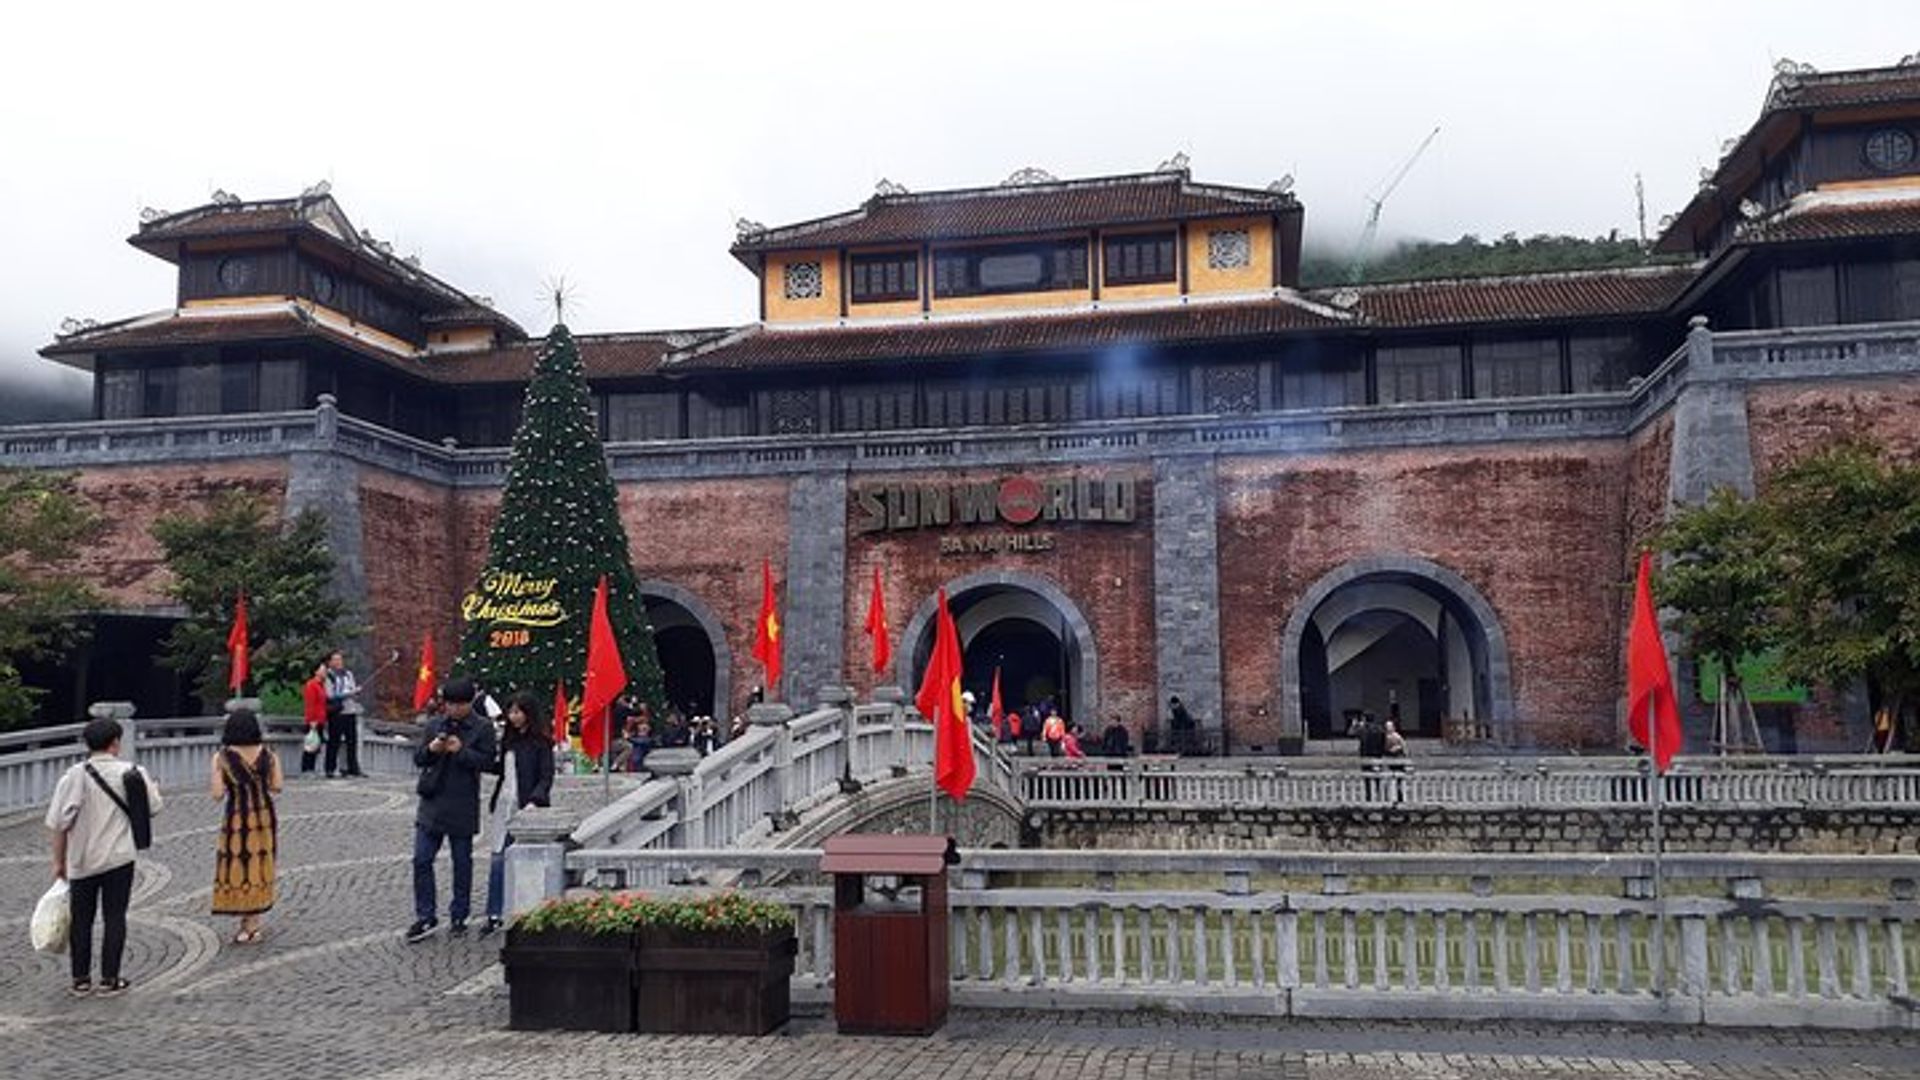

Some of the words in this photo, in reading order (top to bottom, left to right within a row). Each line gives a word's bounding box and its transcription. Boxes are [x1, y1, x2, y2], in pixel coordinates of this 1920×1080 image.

[856, 480, 951, 532] SUN
[953, 474, 1135, 524] WORLD
[1003, 533, 1055, 550] HILLS
[483, 570, 559, 600] Merry
[461, 591, 570, 627] Christmas
